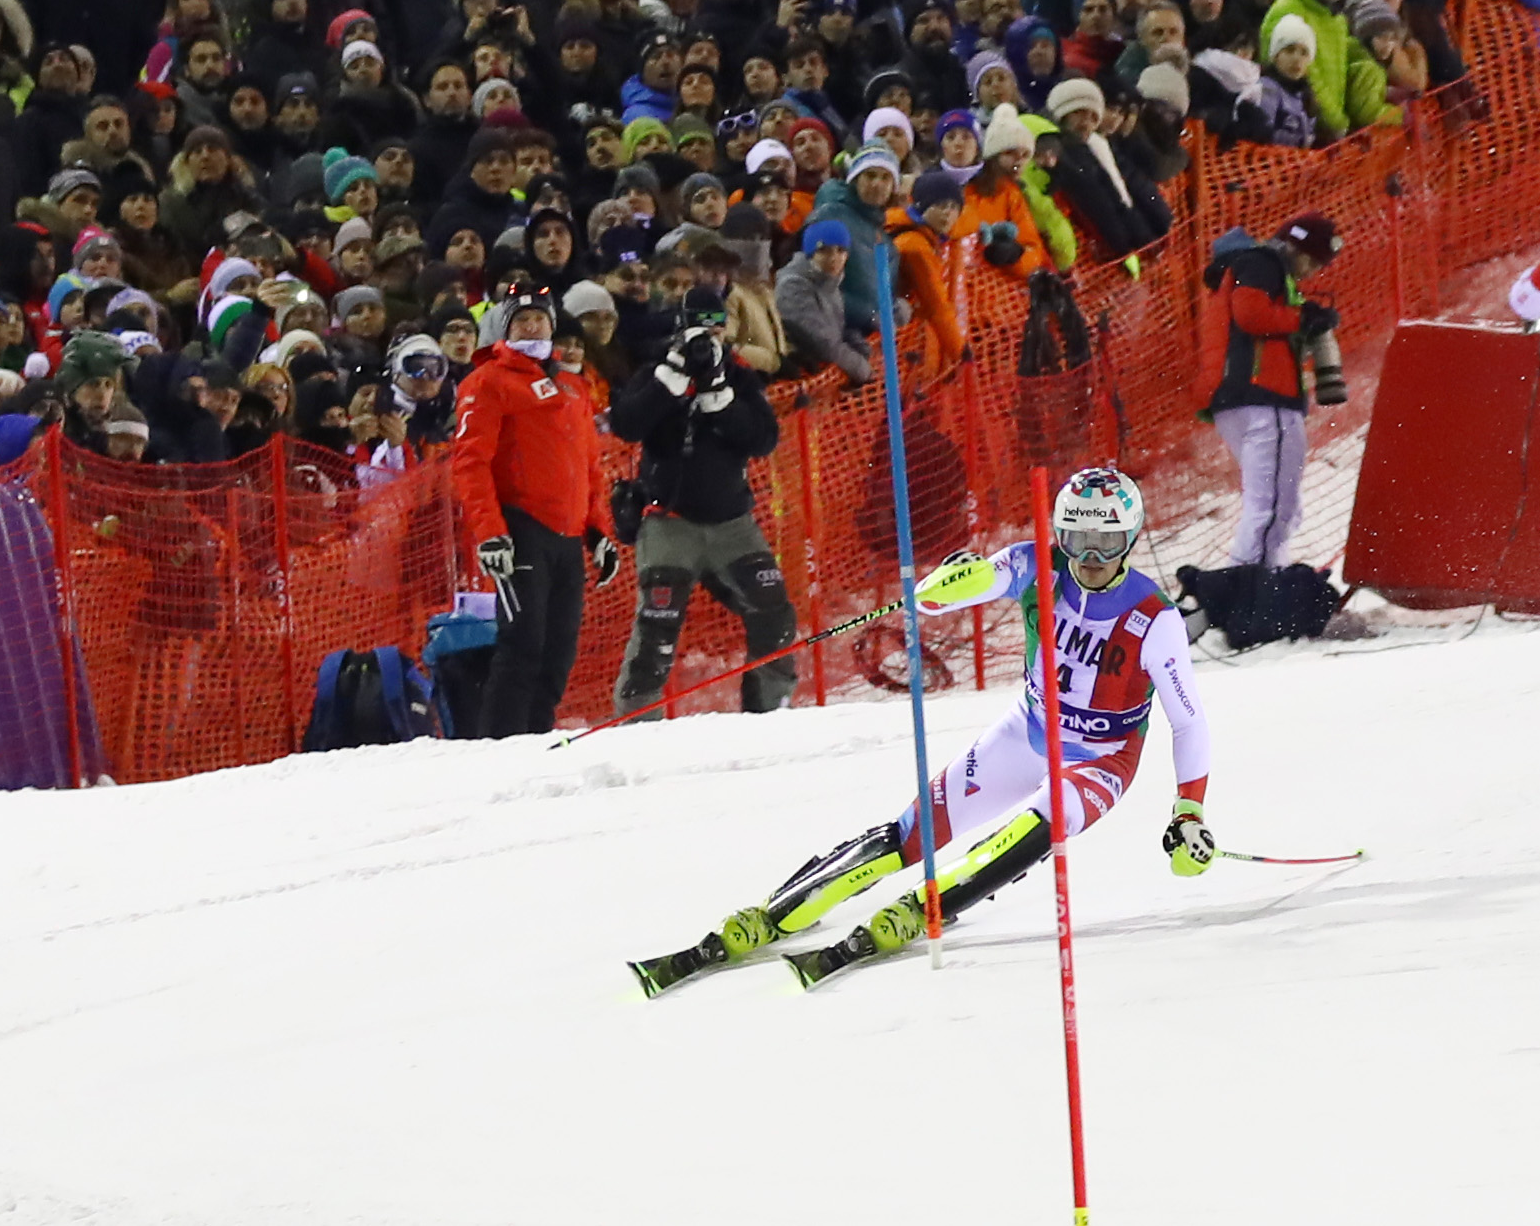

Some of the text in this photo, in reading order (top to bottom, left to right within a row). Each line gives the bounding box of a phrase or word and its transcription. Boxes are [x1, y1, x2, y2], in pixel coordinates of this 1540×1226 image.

[1064, 507, 1107, 518] helvetia
[941, 567, 972, 587] LEKI
[1167, 668, 1197, 718] swisscom
[848, 867, 875, 884] LEKI
